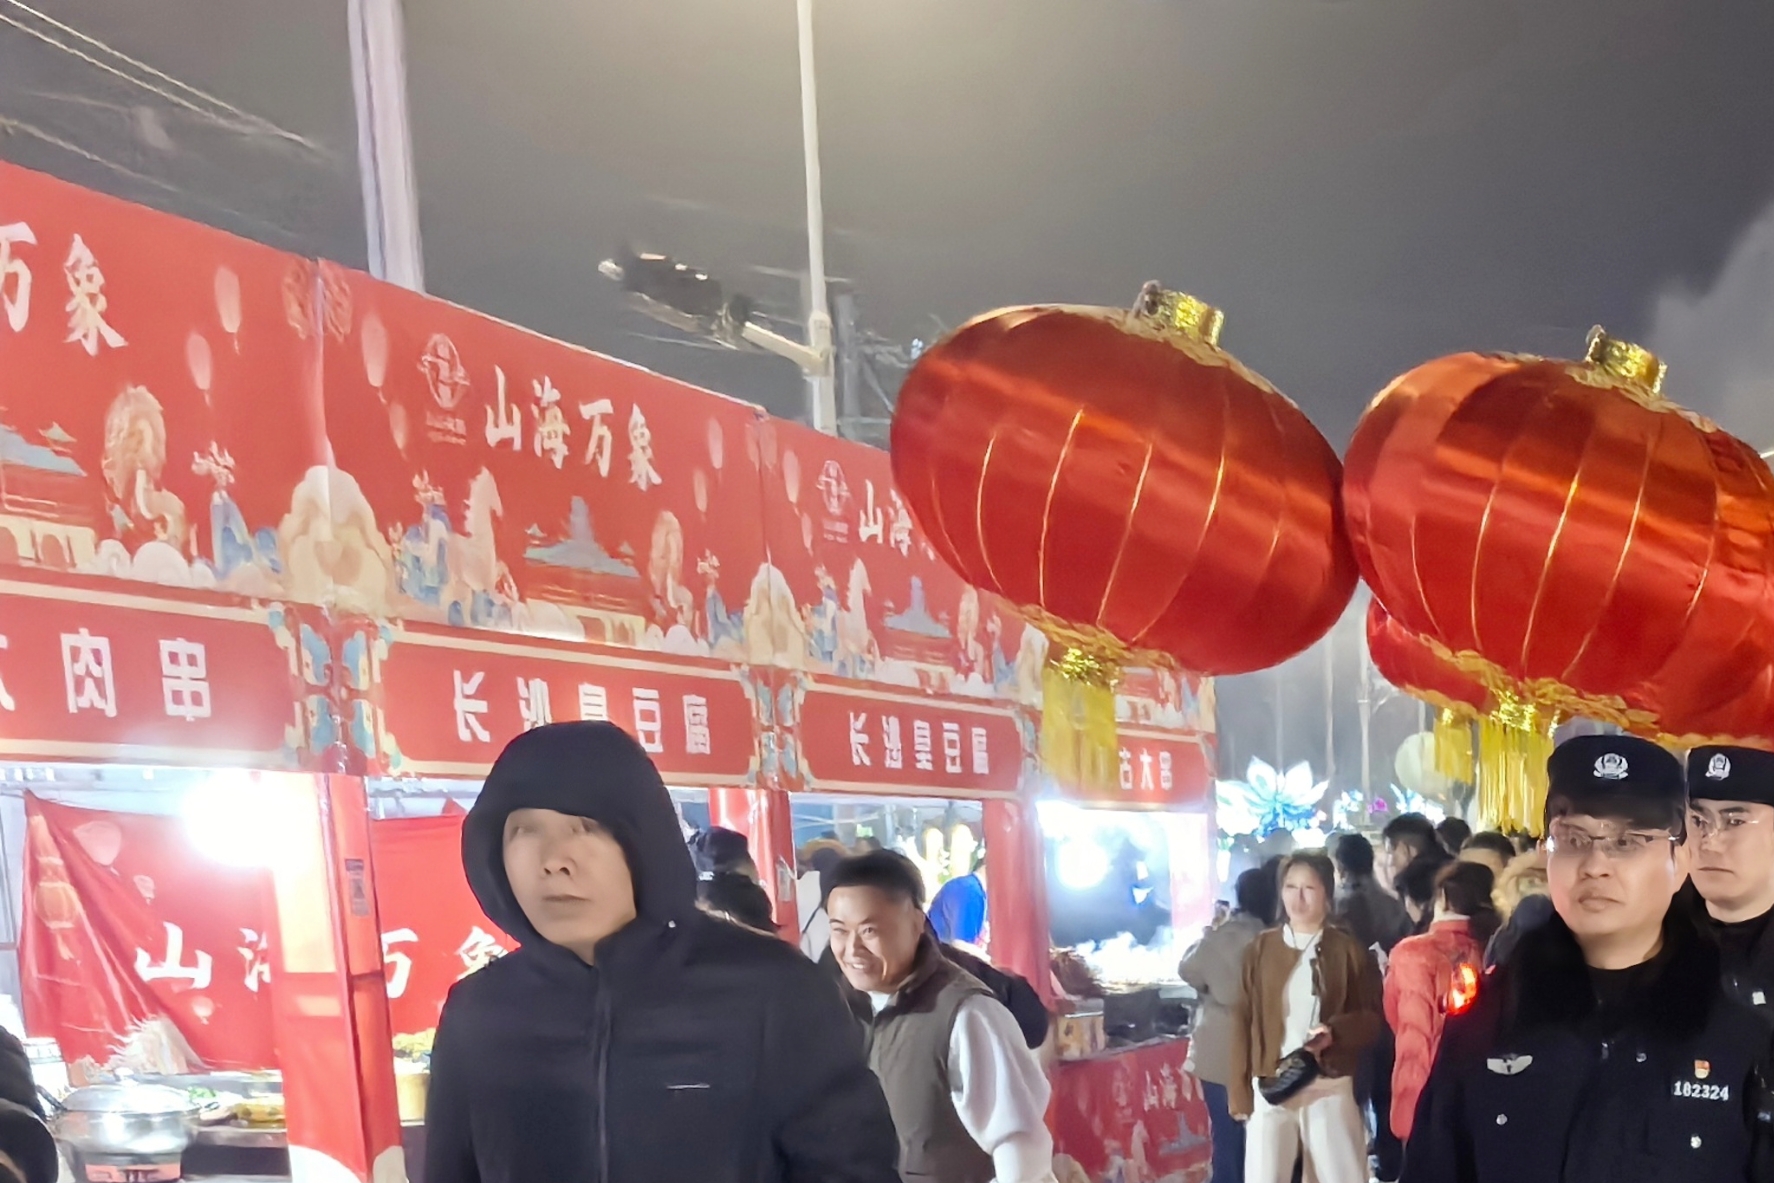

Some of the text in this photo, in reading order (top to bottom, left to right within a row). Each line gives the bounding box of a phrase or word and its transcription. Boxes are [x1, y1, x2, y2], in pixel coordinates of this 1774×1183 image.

[485, 364, 662, 491] 山海万象
[859, 479, 936, 561] 山海
